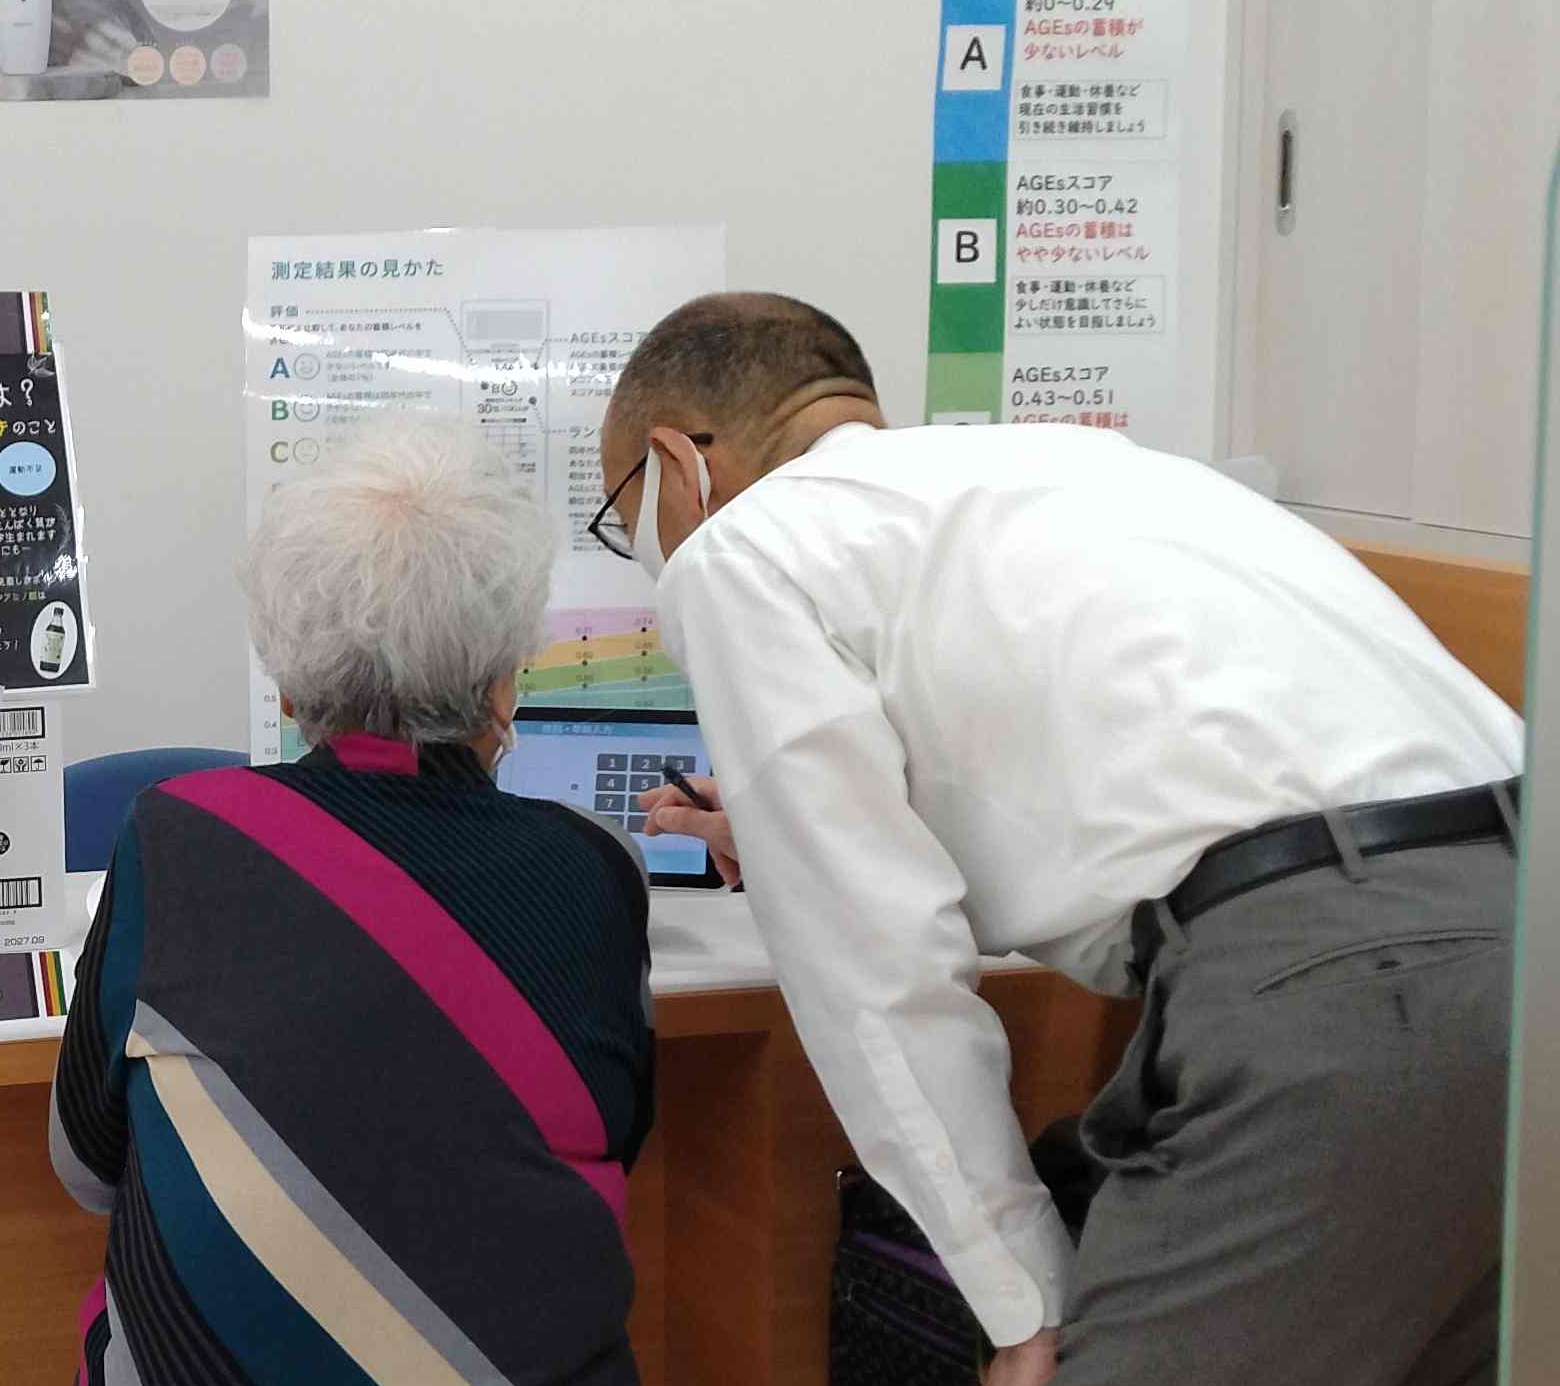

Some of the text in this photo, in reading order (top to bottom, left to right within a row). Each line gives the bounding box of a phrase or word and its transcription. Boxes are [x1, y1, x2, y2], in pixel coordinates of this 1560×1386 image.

[1024, 18, 1144, 36] AGEsの蓄積が
[960, 36, 988, 70] A
[1024, 42, 1125, 60] 少ないレベル
[1016, 175, 1113, 191] AGEsスコア
[1016, 221, 1133, 239] AGEsの蓄積は
[955, 230, 981, 263] B
[1016, 245, 1150, 262] やや少ないレベル
[271, 258, 445, 281] 測定結果の見かた
[269, 357, 290, 379] A
[1012, 366, 1109, 383] AGEsスコア
[270, 399, 290, 421] B
[269, 441, 290, 463] C
